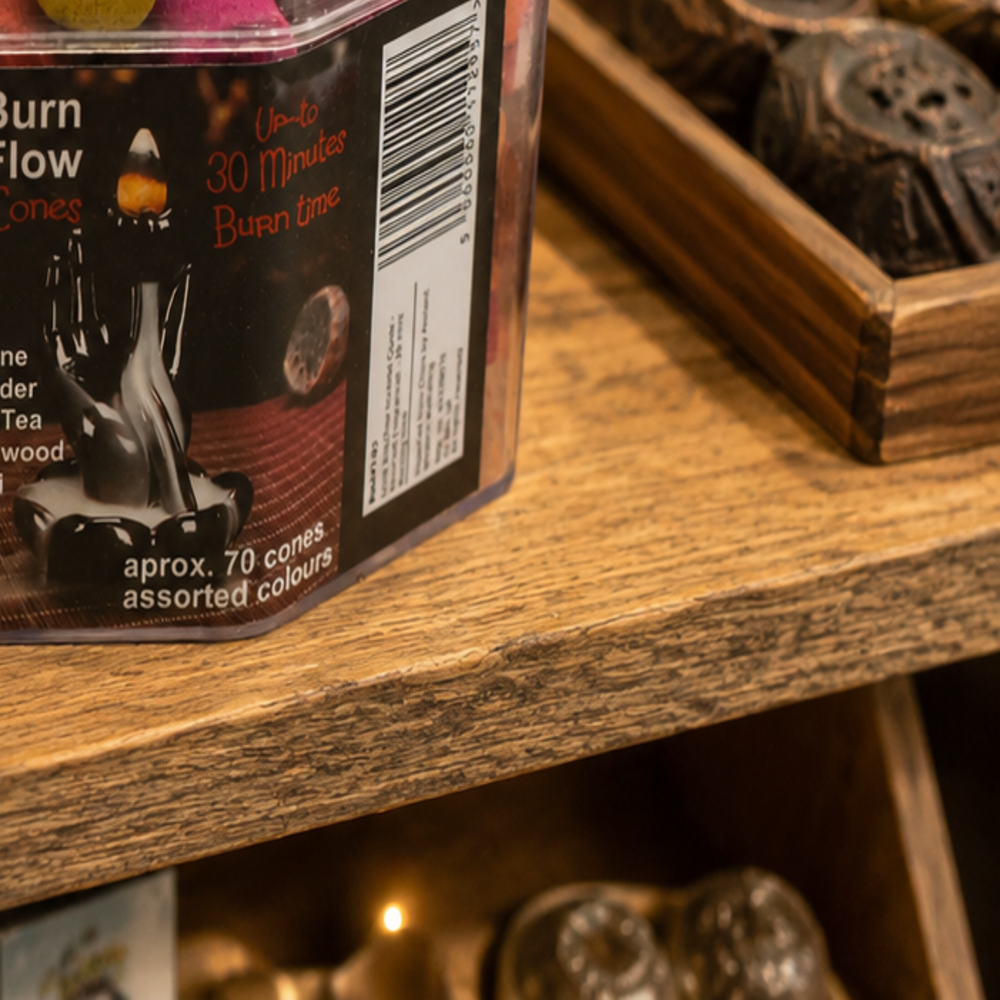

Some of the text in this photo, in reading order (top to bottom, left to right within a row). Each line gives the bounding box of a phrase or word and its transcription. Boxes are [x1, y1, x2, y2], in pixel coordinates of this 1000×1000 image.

[206, 128, 347, 194] 30 Minutes
[213, 186, 340, 248] Burn time
[1, 408, 42, 430] Tea
[123, 521, 324, 584] aprox. 70 cones
[123, 547, 333, 609] assorted colours
